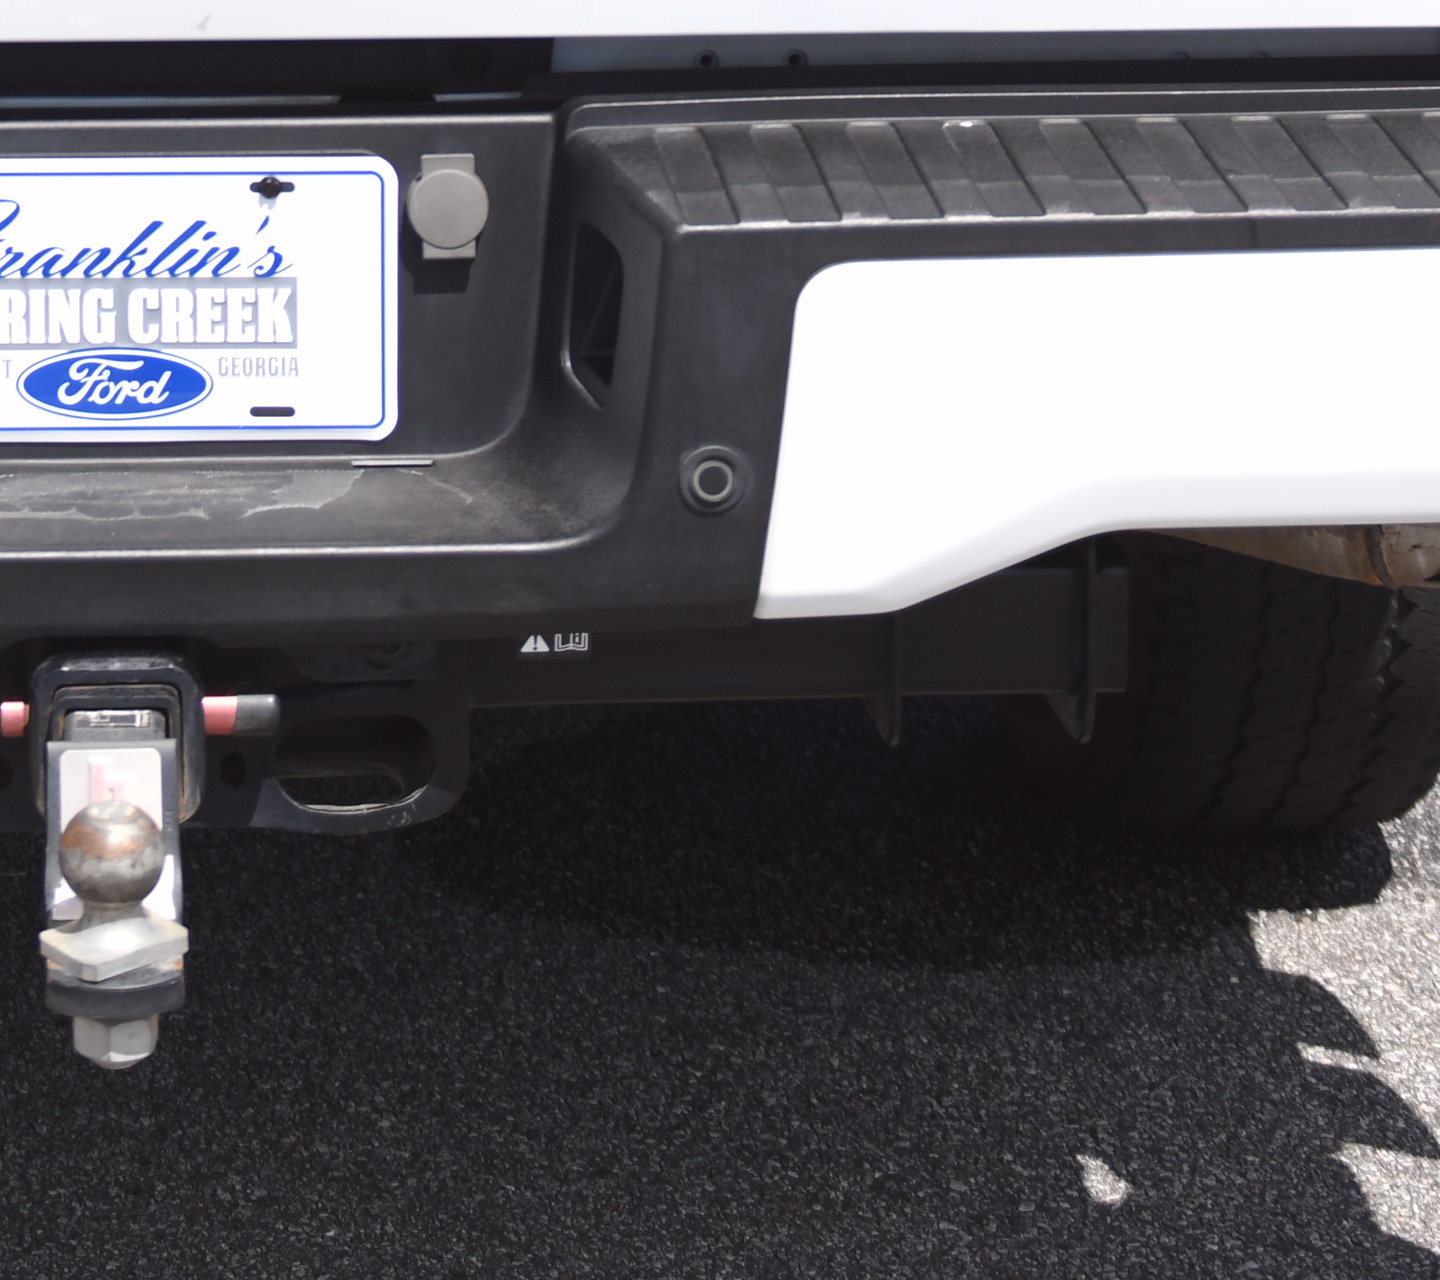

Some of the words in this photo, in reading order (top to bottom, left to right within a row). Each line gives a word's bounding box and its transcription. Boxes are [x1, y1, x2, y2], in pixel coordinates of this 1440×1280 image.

[127, 286, 295, 345] CREEK
[57, 356, 171, 408] Ford
[217, 356, 300, 378] GEORGIA
